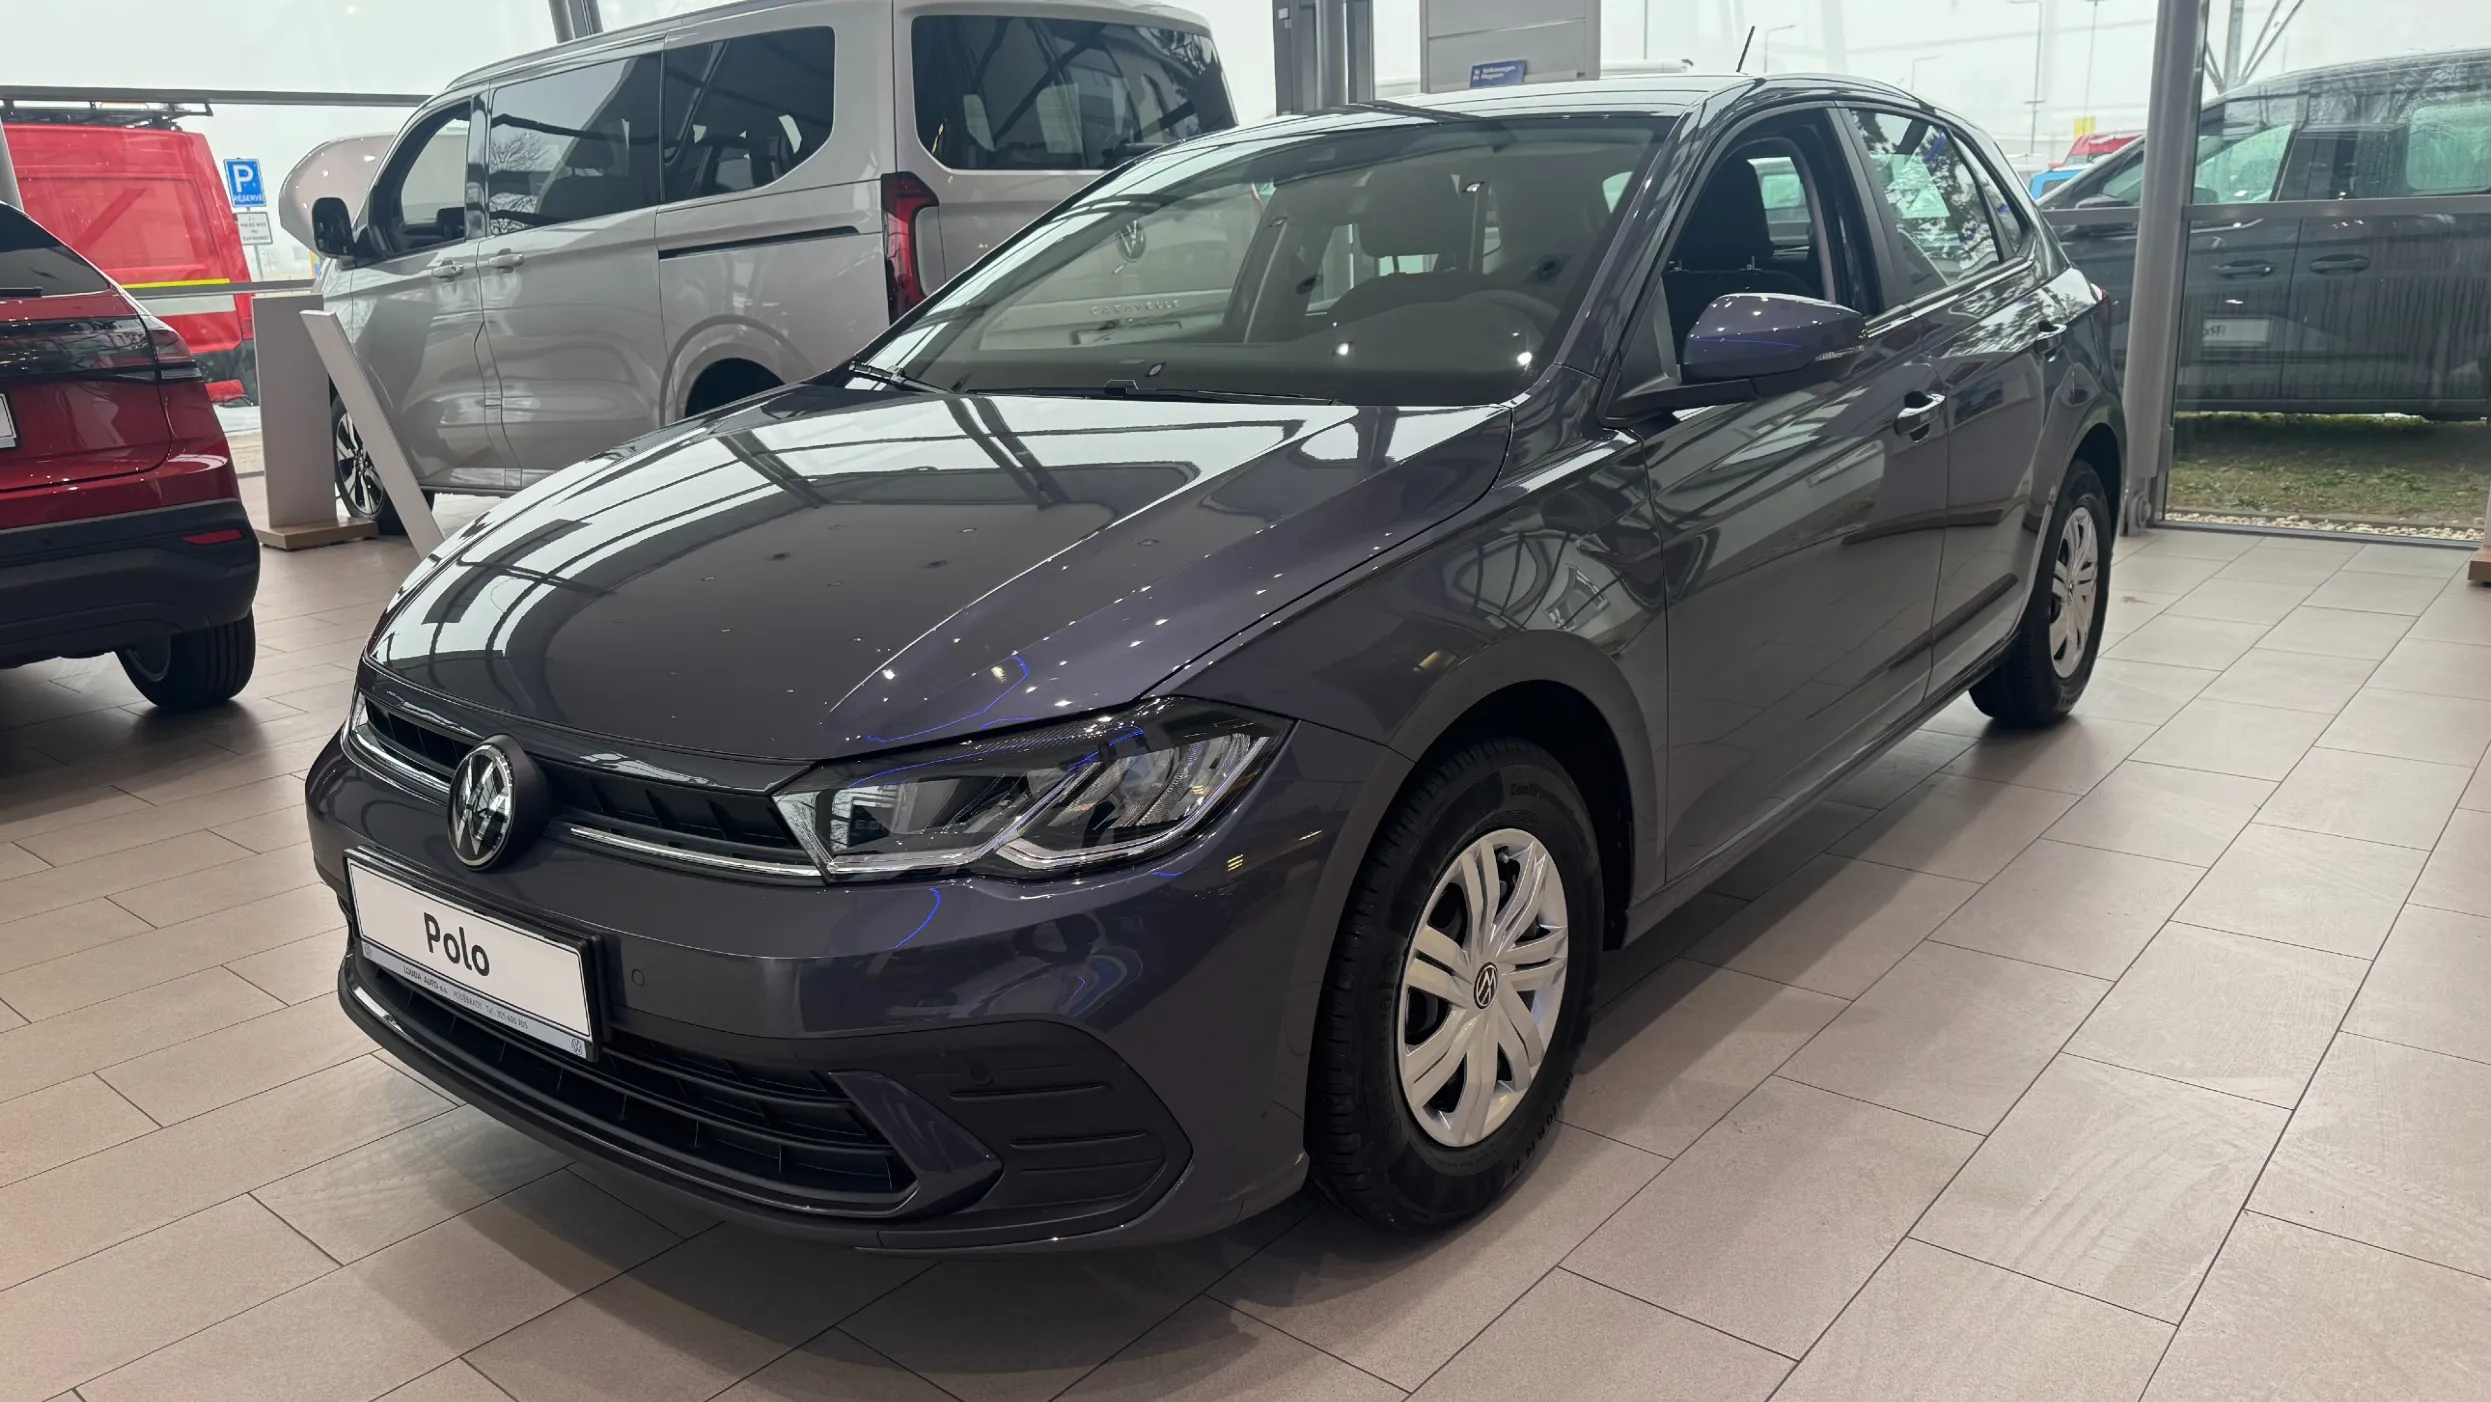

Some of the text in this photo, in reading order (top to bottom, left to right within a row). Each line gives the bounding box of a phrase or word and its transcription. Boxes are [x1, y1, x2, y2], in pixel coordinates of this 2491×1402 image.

[232, 164, 254, 193] P
[1090, 299, 1179, 315] CARAVELLE
[423, 911, 490, 977] Polo
[403, 965, 422, 981] LOUDA
[424, 976, 439, 990] AUTO
